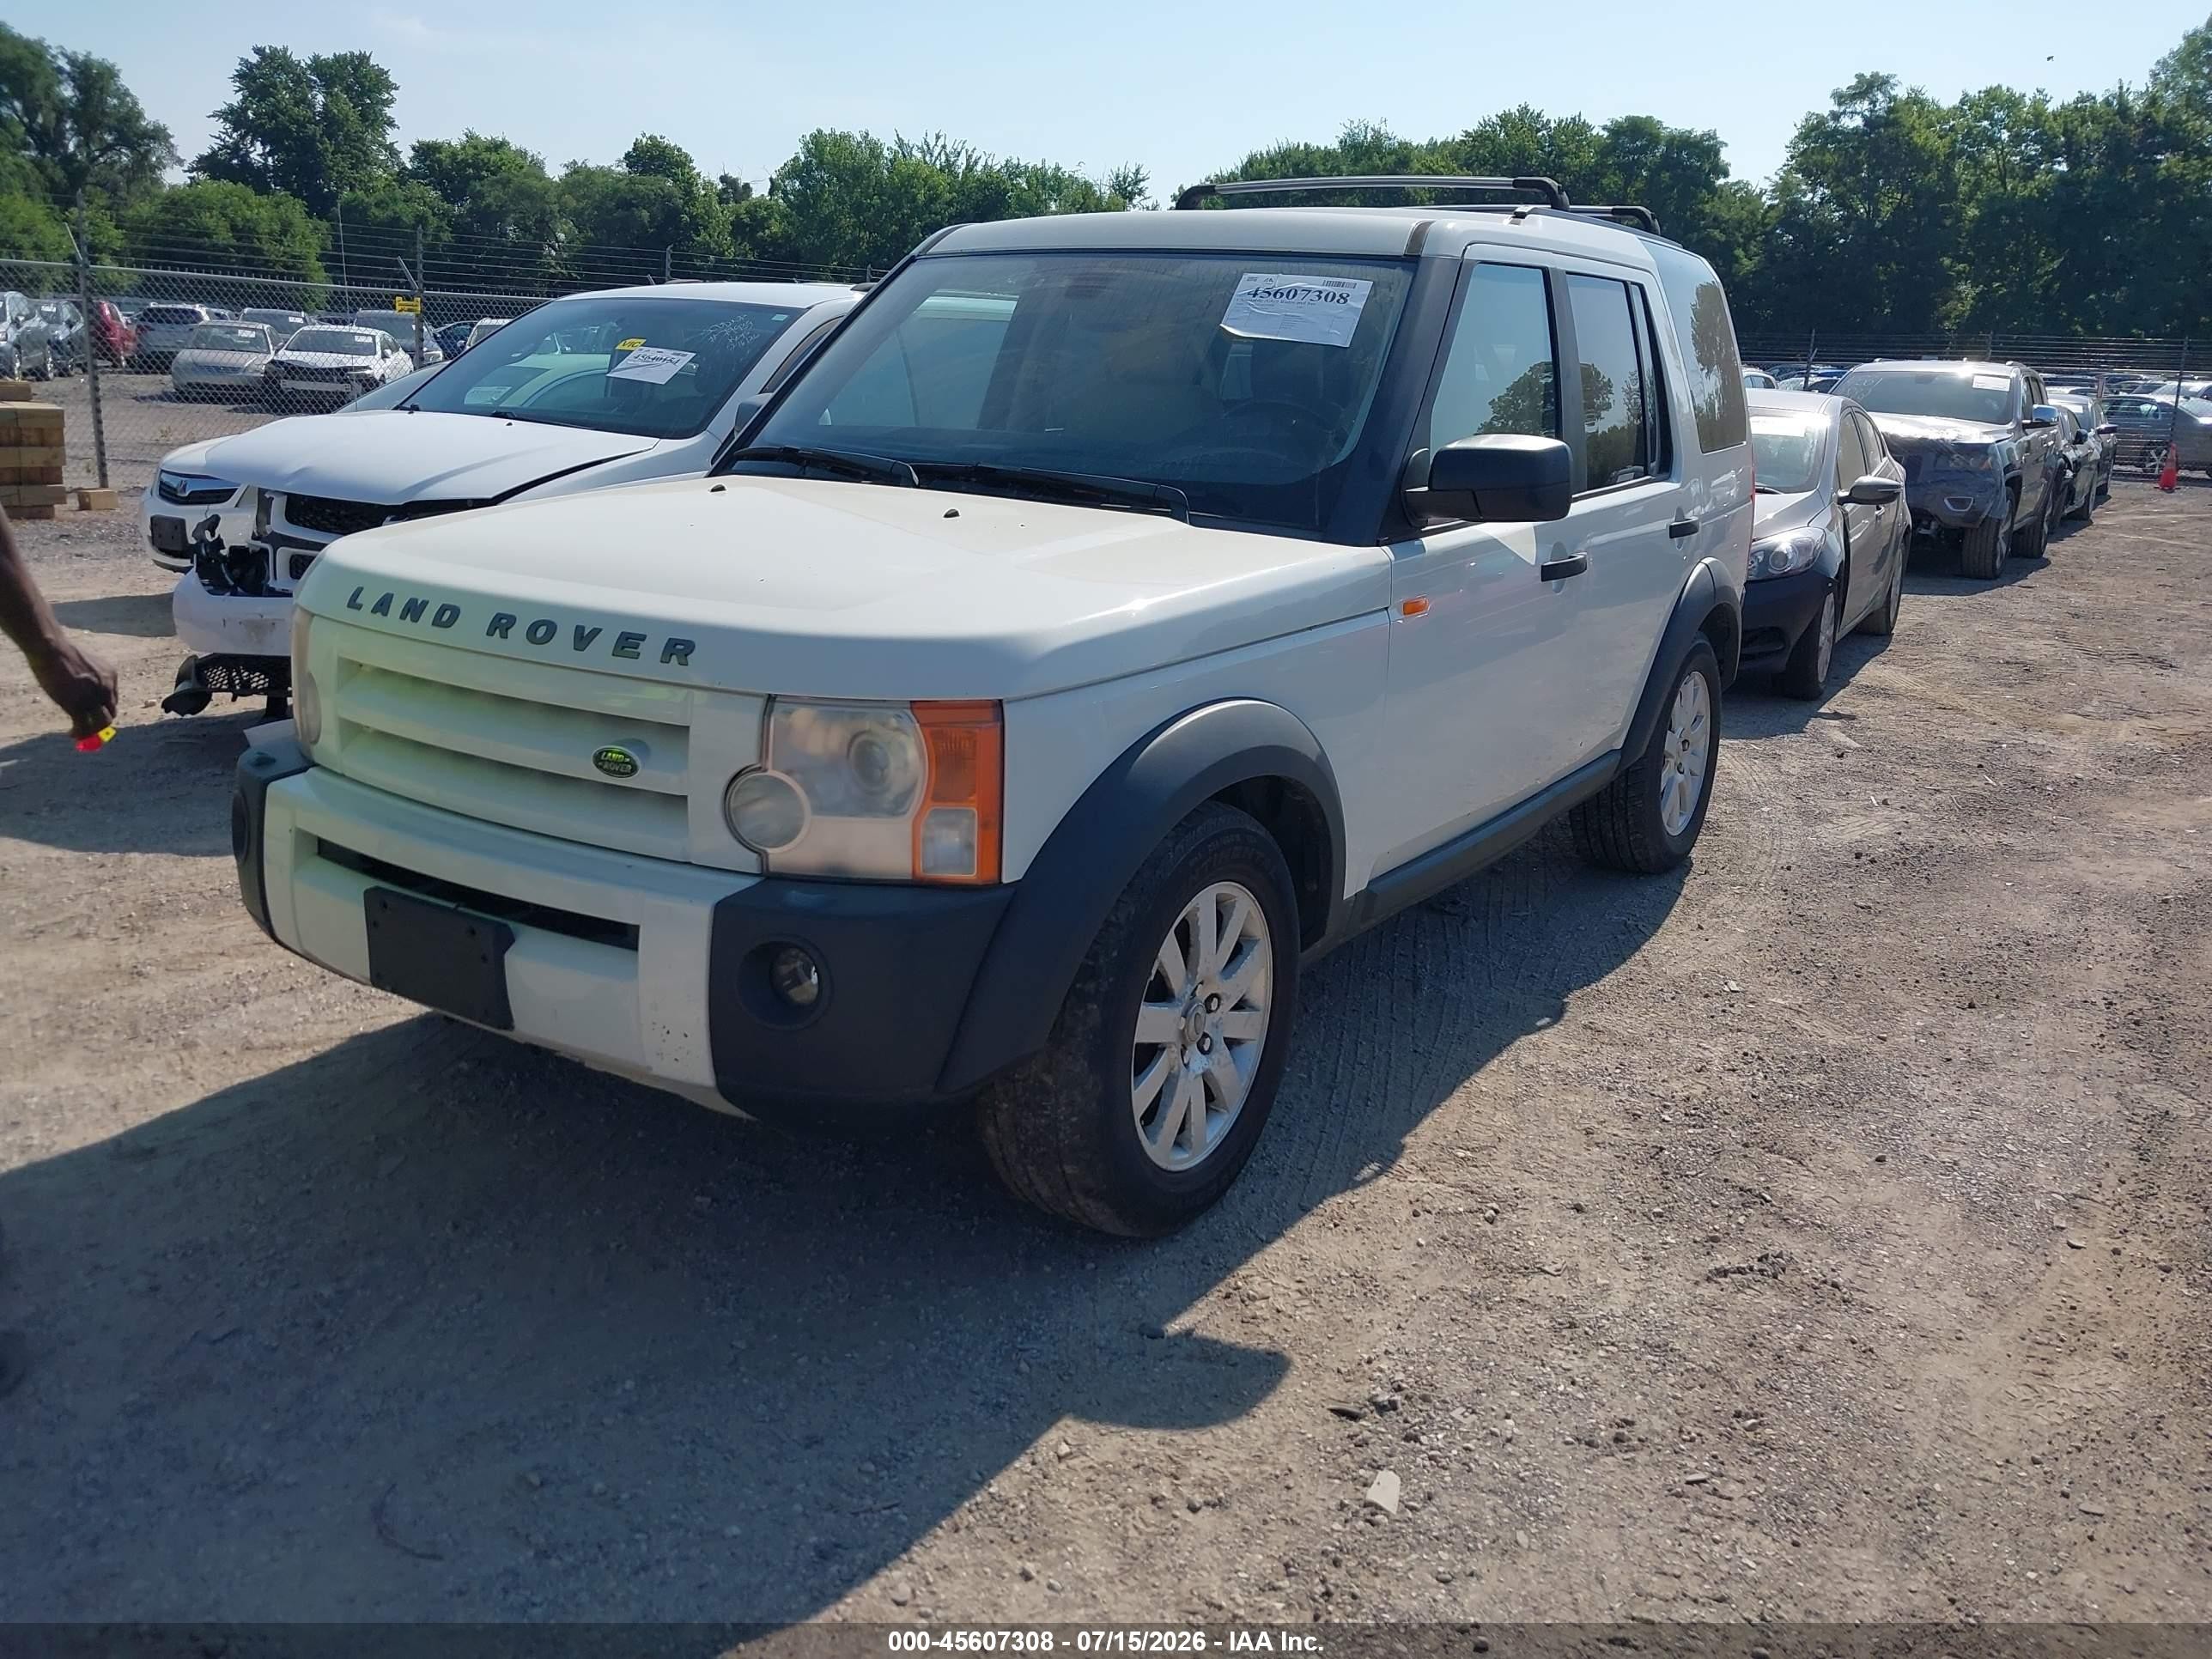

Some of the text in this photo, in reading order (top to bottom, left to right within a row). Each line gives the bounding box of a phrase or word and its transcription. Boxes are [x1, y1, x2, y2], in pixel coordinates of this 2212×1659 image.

[1247, 287, 1350, 305] 45607308
[346, 586, 696, 665] LAND ROVER
[601, 751, 625, 763] LAND
[603, 761, 632, 773] ROVER
